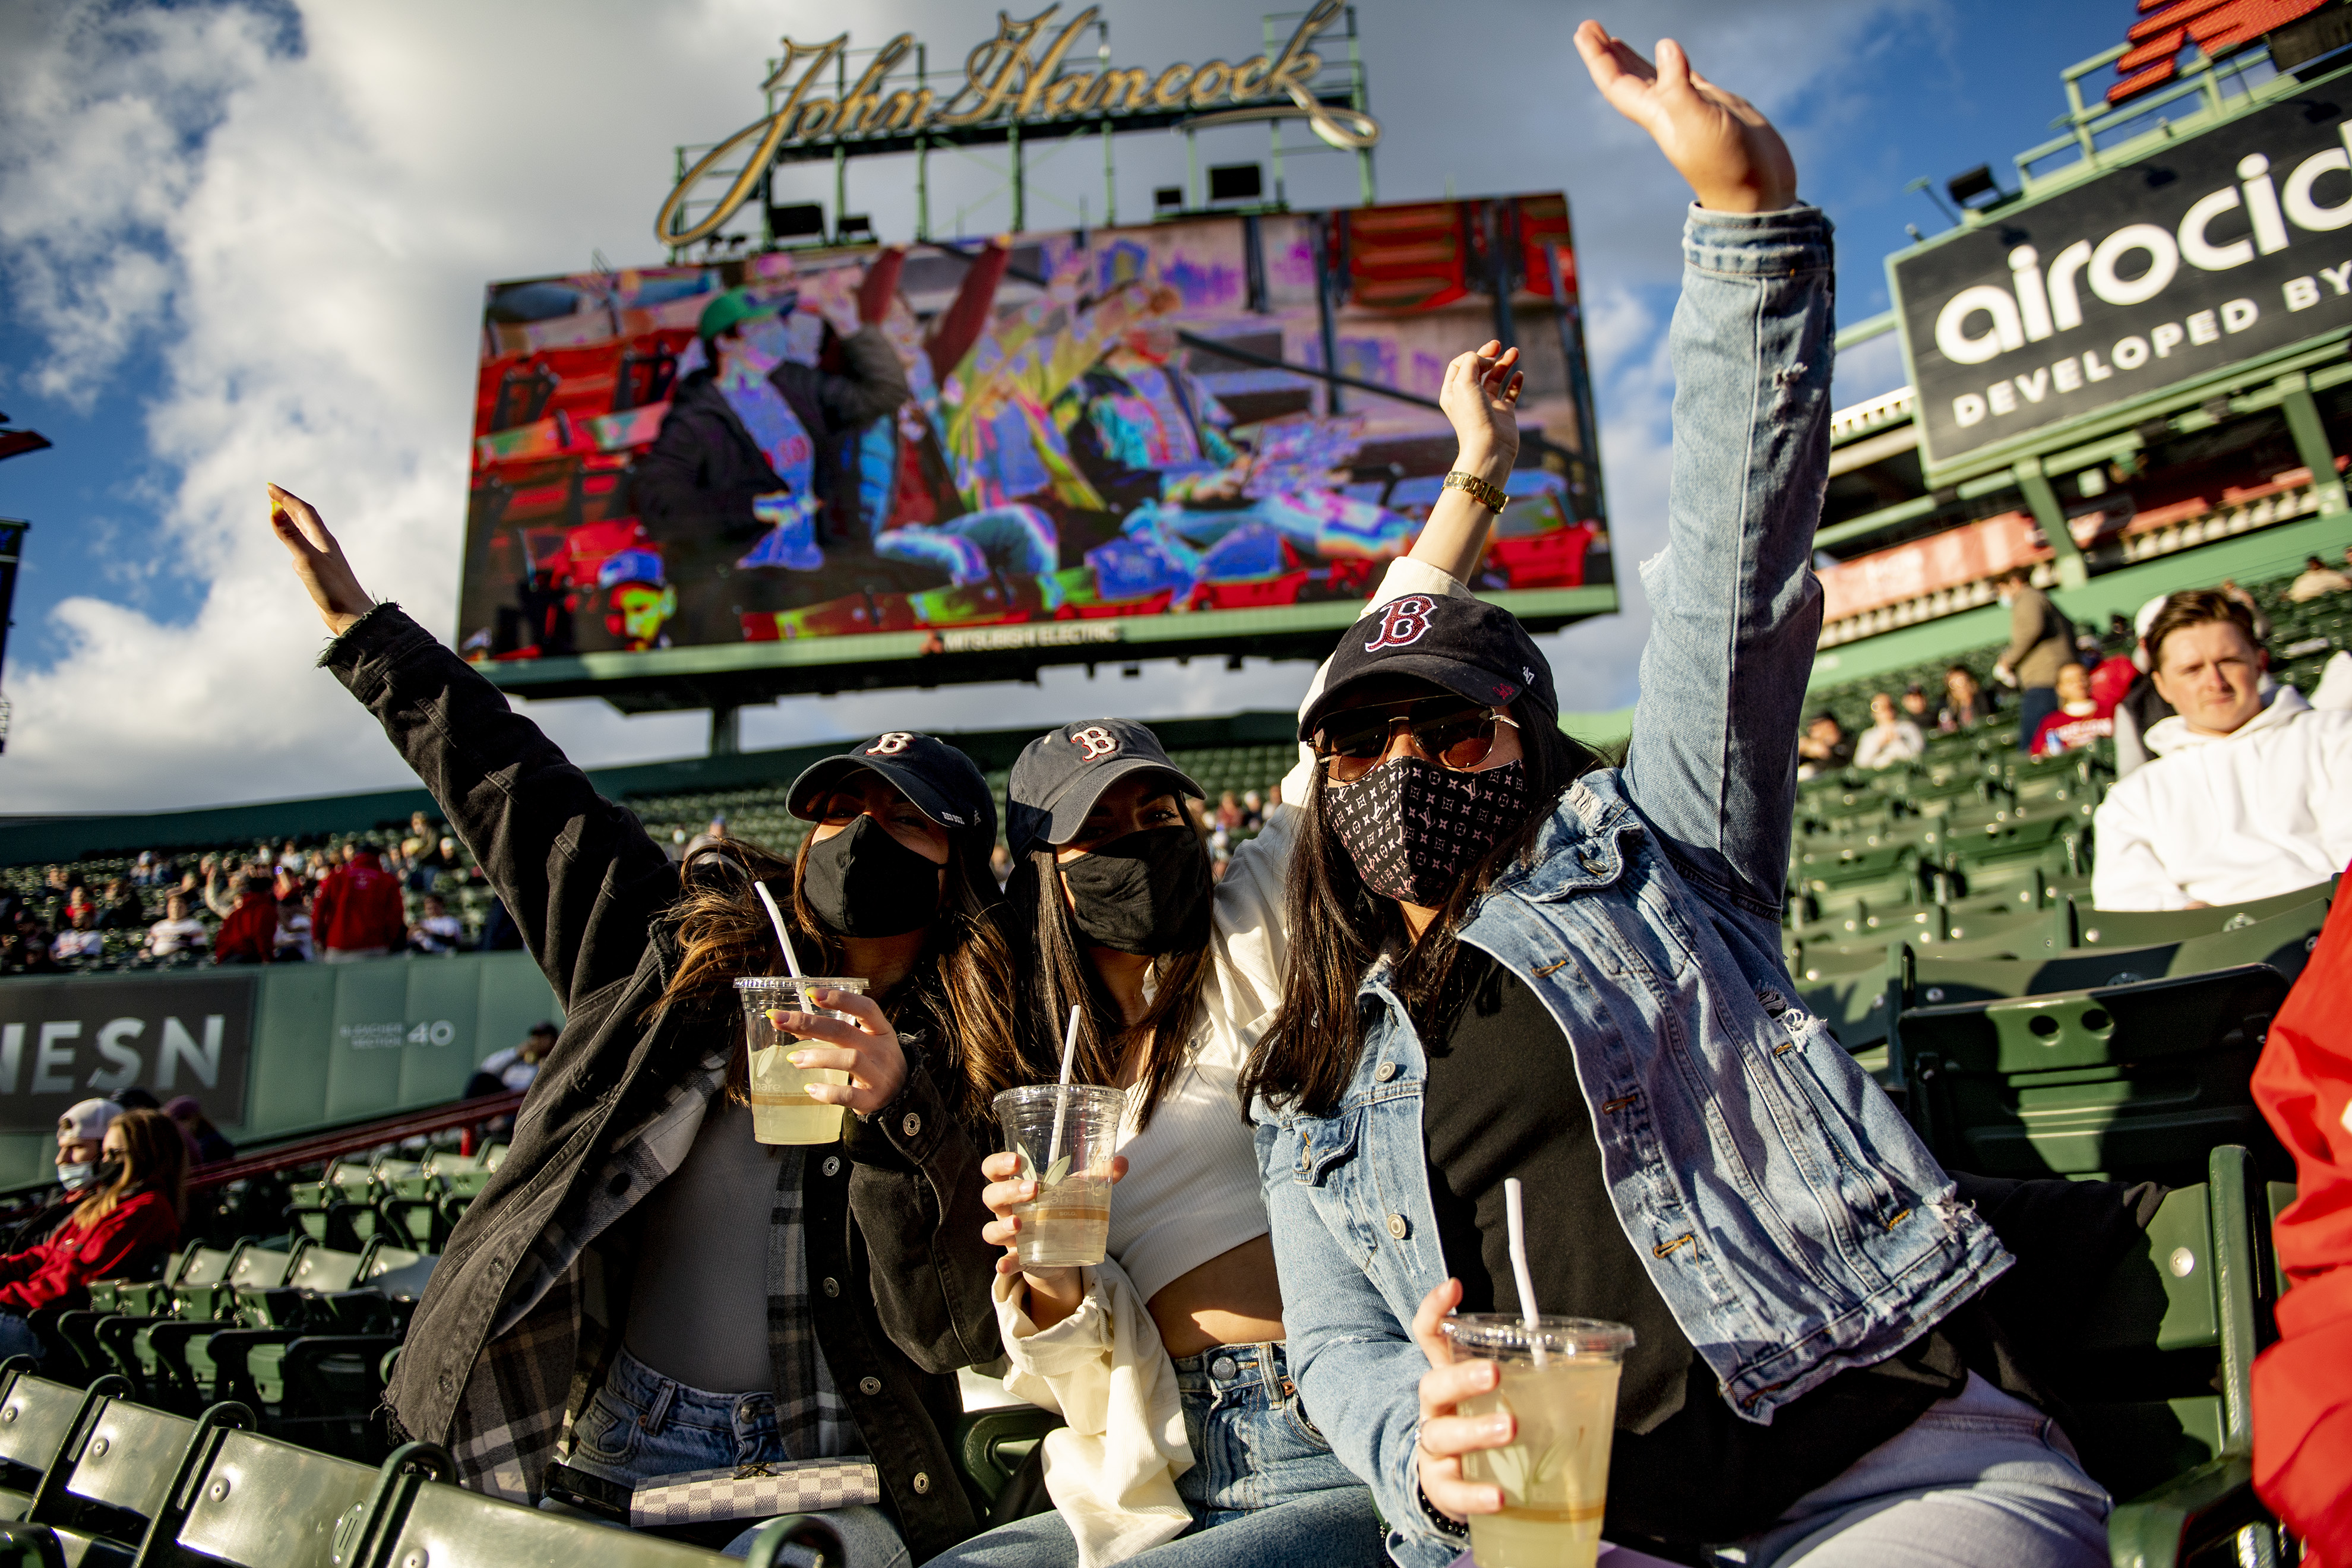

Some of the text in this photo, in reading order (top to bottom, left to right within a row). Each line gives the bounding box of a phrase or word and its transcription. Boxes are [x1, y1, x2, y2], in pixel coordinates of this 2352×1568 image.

[655, 0, 1382, 248] John Hancock
[1952, 259, 2352, 428] DEVELOPED BY
[944, 621, 1121, 652] MITSUBISHI ELECTRIC
[1365, 595, 1438, 652] B
[866, 732, 916, 755] B
[1071, 726, 1119, 761] B
[407, 1019, 456, 1047] 40
[755, 1080, 781, 1092] bare
